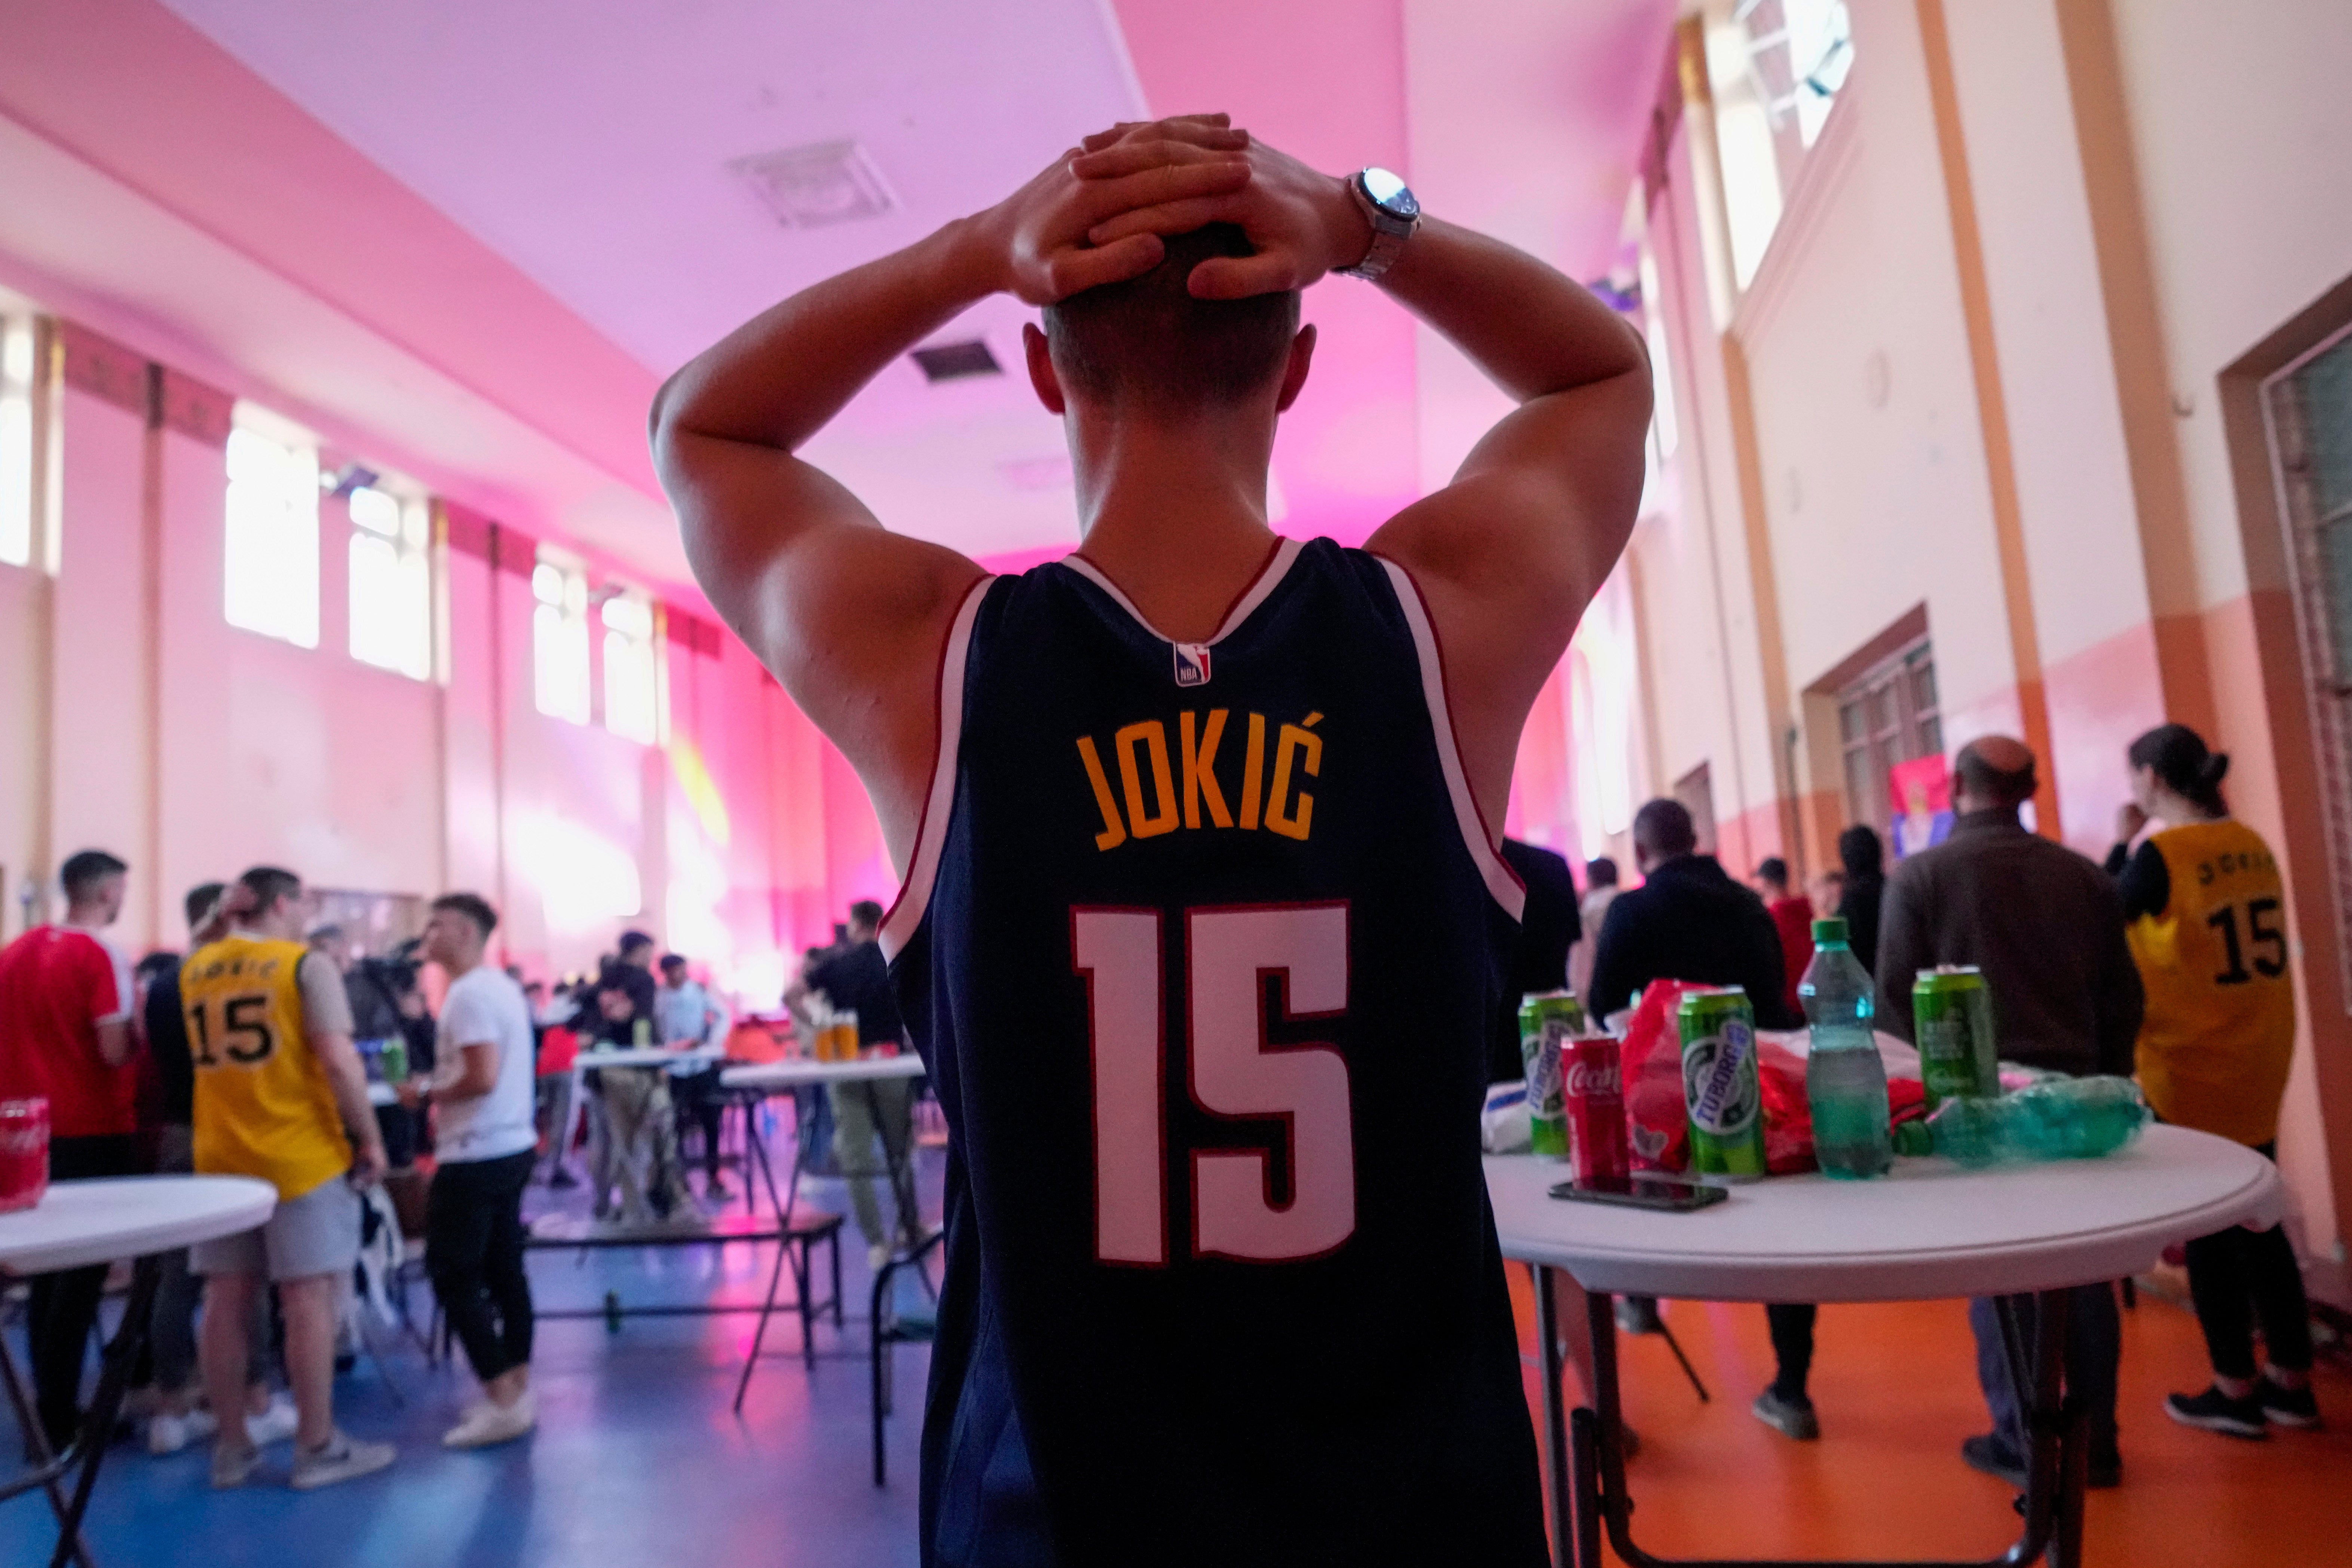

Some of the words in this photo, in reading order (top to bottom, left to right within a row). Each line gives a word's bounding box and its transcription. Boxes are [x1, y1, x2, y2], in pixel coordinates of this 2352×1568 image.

[1180, 667, 1197, 682] NBA
[1077, 709, 1324, 851] JOKIĆ
[2208, 897, 2288, 985] 15
[192, 995, 273, 1065] 15
[1070, 902, 1356, 1268] 15
[1696, 1043, 1743, 1124] TUBORG
